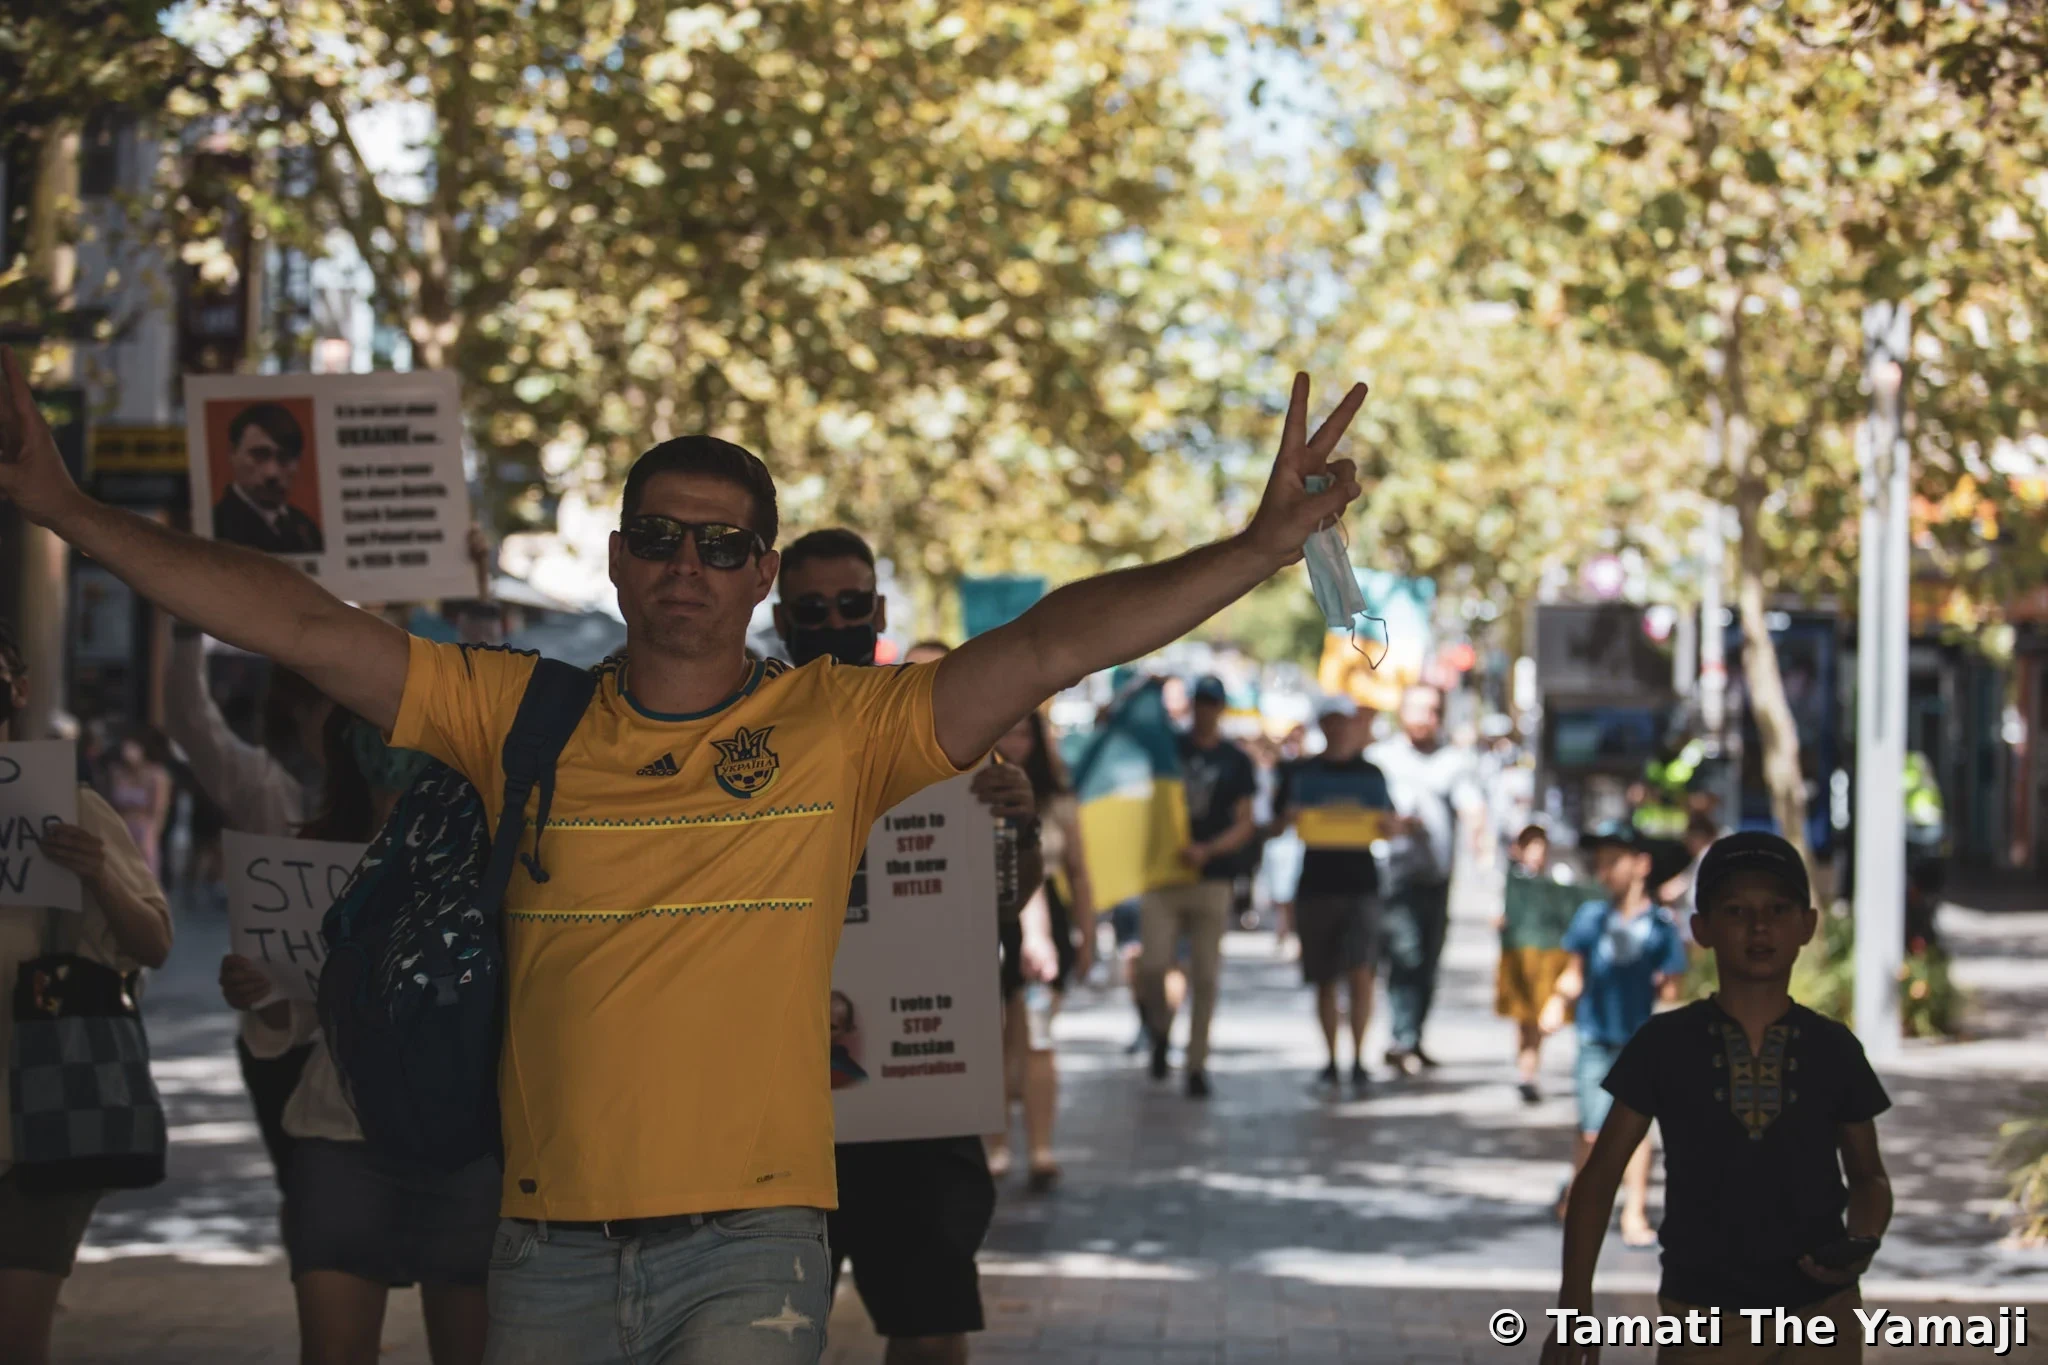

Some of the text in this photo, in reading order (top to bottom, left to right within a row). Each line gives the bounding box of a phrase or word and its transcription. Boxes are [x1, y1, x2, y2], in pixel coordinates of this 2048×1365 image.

[721, 758, 774, 774] УКРАЇНА
[885, 813, 946, 831] I vote to
[896, 834, 935, 853] STOP
[886, 858, 948, 874] the new
[892, 877, 942, 897] HITLER
[890, 994, 953, 1012] I vote to
[902, 1015, 943, 1035] STOP
[891, 1037, 955, 1057] Russian
